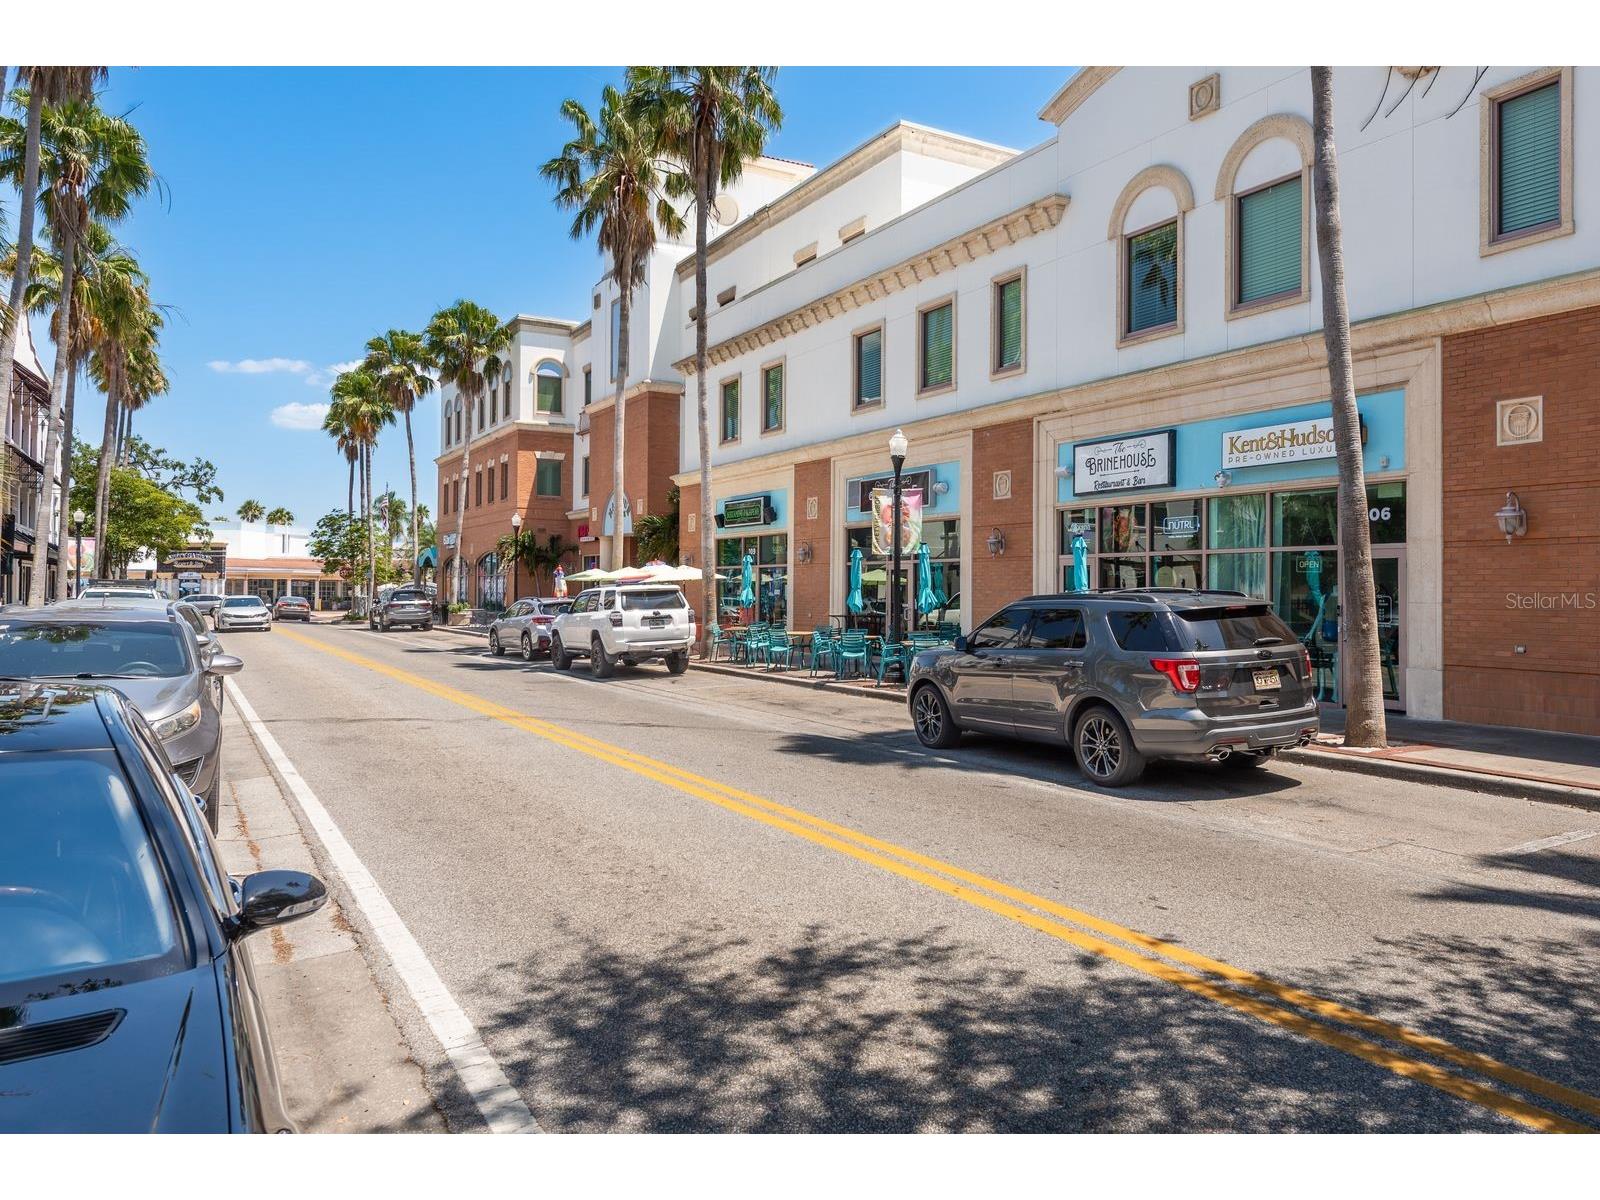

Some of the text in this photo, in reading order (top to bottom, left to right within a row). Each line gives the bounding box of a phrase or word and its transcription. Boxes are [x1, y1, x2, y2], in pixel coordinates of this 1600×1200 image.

[1228, 424, 1336, 455] Kent&Hudso
[1113, 442, 1125, 454] The
[1228, 445, 1337, 463] PRE-OWNED LUXU
[1085, 447, 1156, 476] BRINEHOUSE
[1093, 478, 1125, 491] Restaurant
[1369, 507, 1391, 521] 06
[1299, 559, 1320, 569] OPEN
